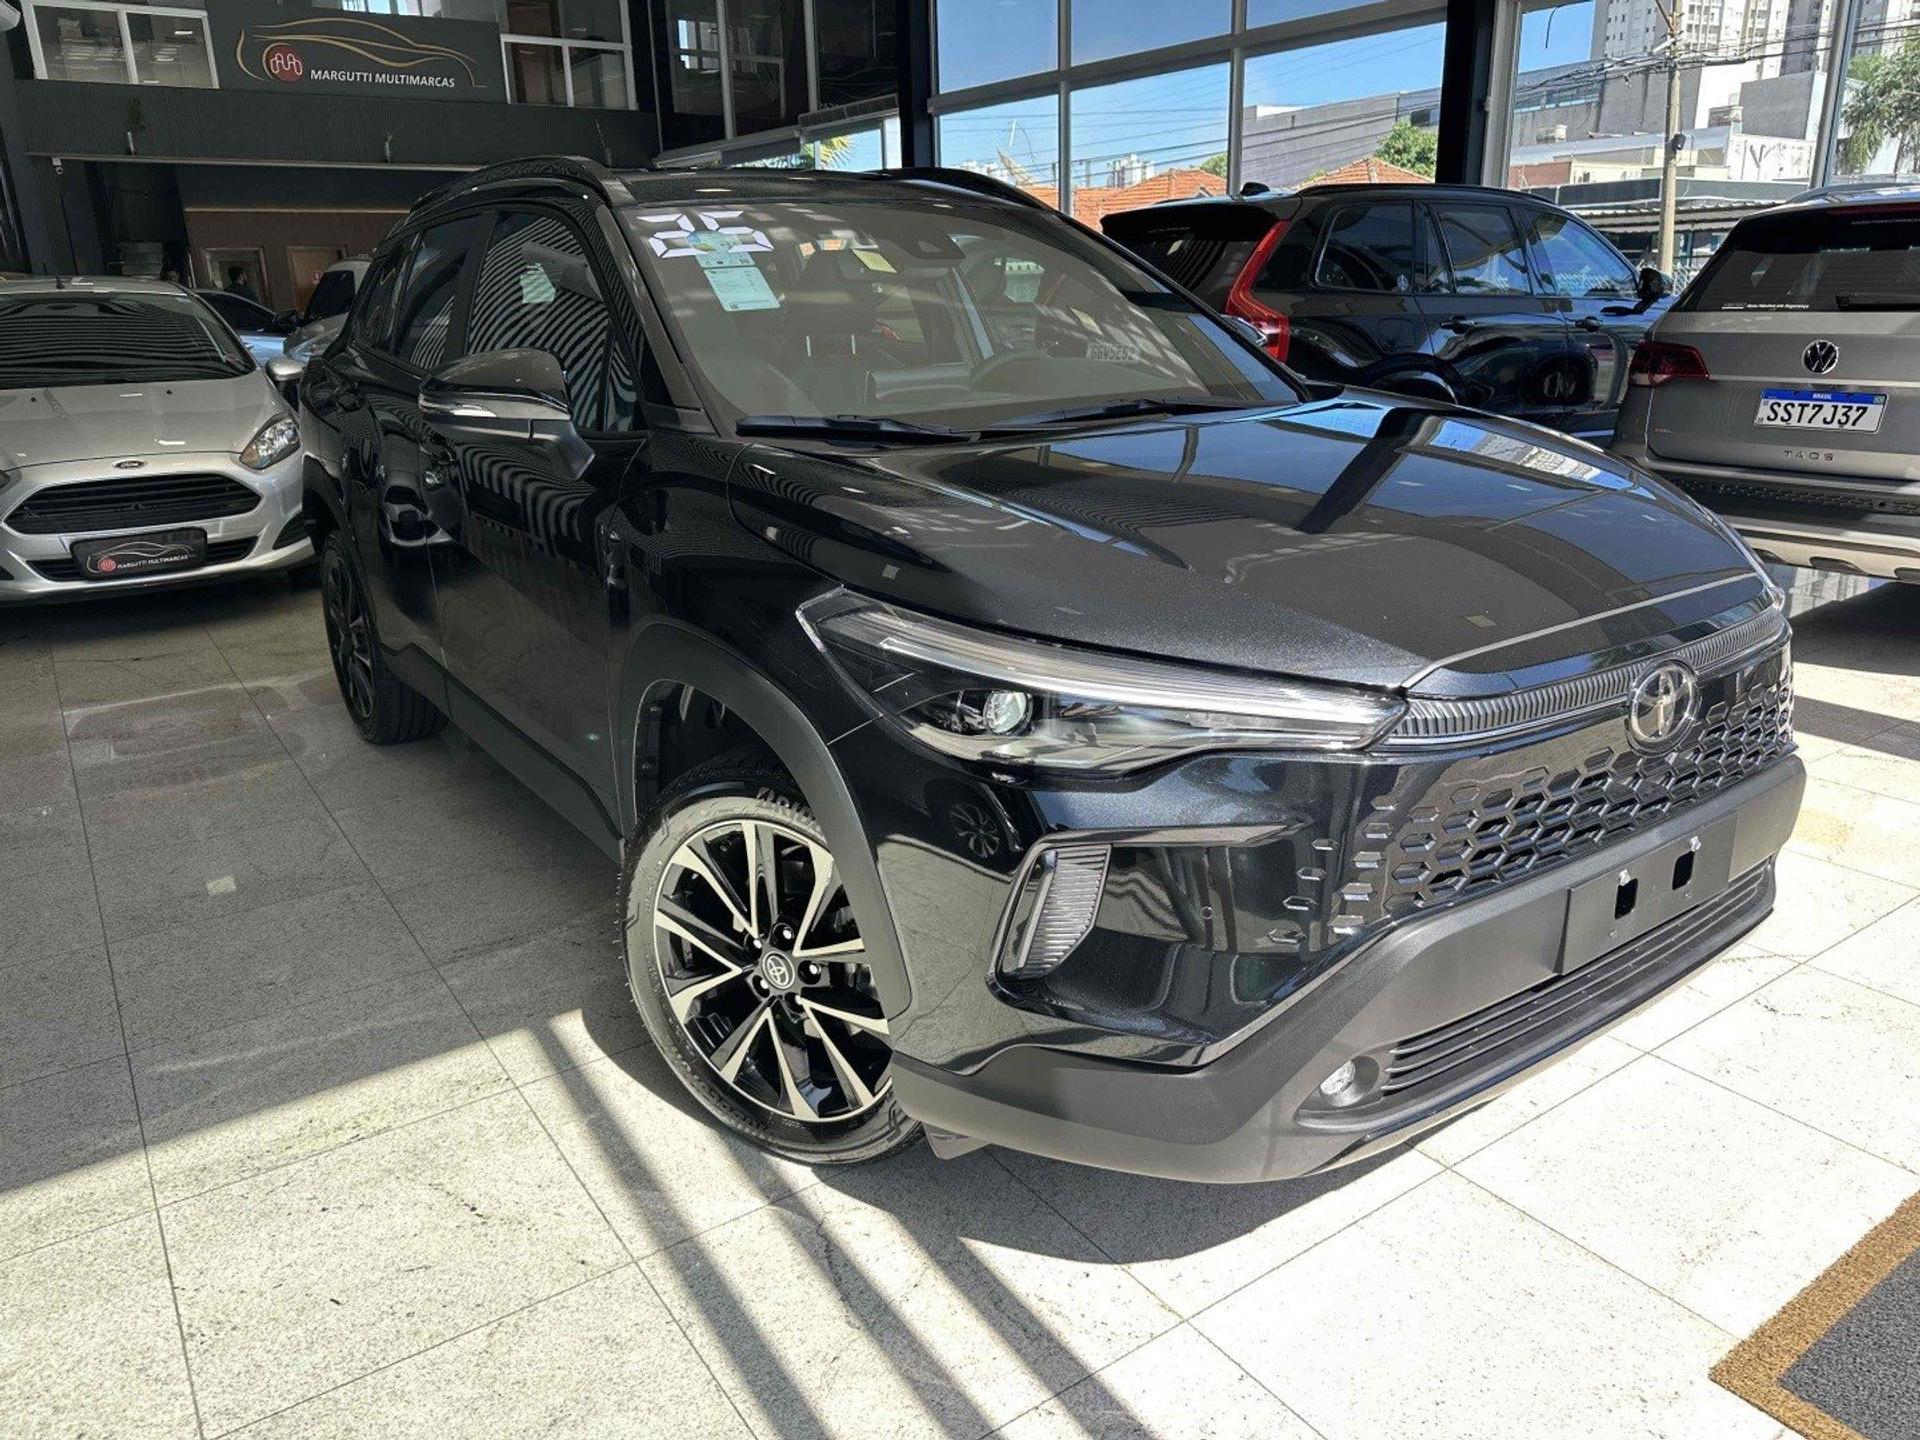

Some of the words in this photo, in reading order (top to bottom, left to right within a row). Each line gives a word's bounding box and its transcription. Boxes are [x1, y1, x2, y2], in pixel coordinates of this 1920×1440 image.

[310, 69, 372, 83] MARGUTTI
[374, 73, 455, 88] MULTIMARCAS
[1766, 402, 1868, 427] SST7J37
[1783, 450, 1834, 461] TAOS
